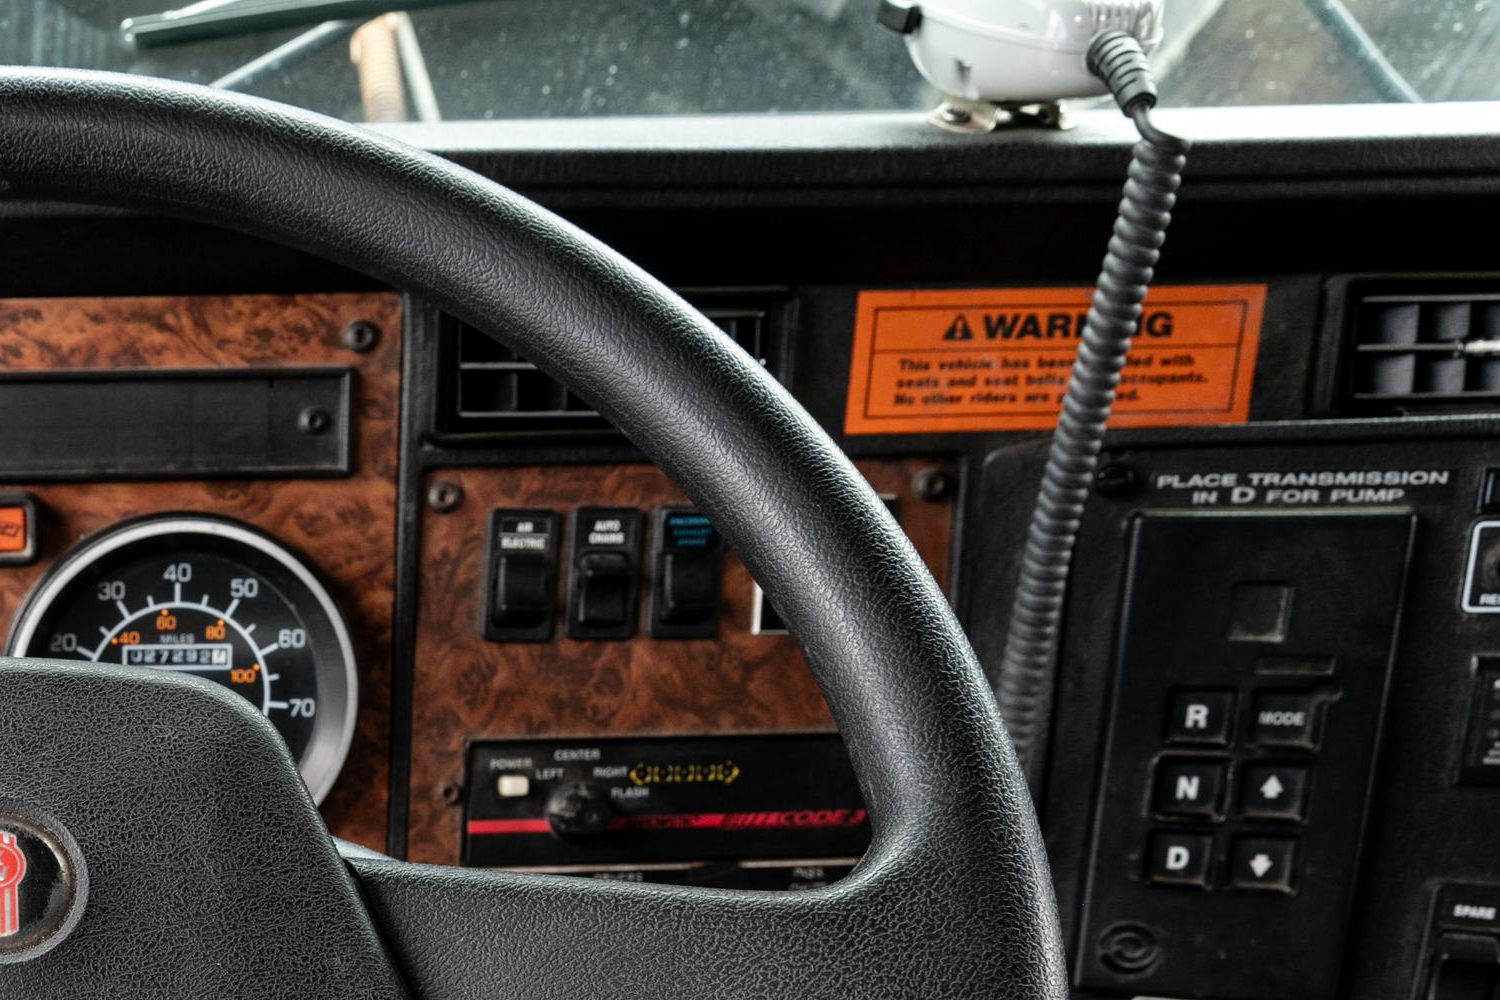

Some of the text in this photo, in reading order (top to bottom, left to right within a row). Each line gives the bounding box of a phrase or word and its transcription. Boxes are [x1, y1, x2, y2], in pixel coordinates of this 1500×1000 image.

[983, 312, 1173, 339] WARG
[947, 376, 977, 387] and
[921, 393, 962, 405] other
[1156, 470, 1449, 489] PLACE TRANSMISSION
[1192, 486, 1405, 504] IN D FOR PUMP
[164, 562, 192, 583] 40
[98, 581, 126, 601] 30
[231, 578, 259, 598] 50
[156, 616, 177, 631] 60
[118, 631, 140, 645] 40
[159, 633, 195, 644] MILES
[205, 626, 226, 641] 80
[278, 629, 306, 649] 60
[52, 633, 78, 653] 20
[231, 669, 256, 683] 100
[289, 698, 316, 718] 70
[1184, 703, 1209, 729] R
[1258, 711, 1306, 727] MODE
[490, 757, 534, 770] POWER
[553, 749, 601, 762] CENTER
[535, 767, 565, 781] LEFT
[592, 766, 629, 779] RIGHT
[610, 786, 650, 799] FLASH
[1176, 776, 1199, 800] N
[1165, 846, 1190, 871] D
[1453, 904, 1497, 920] SPARE
